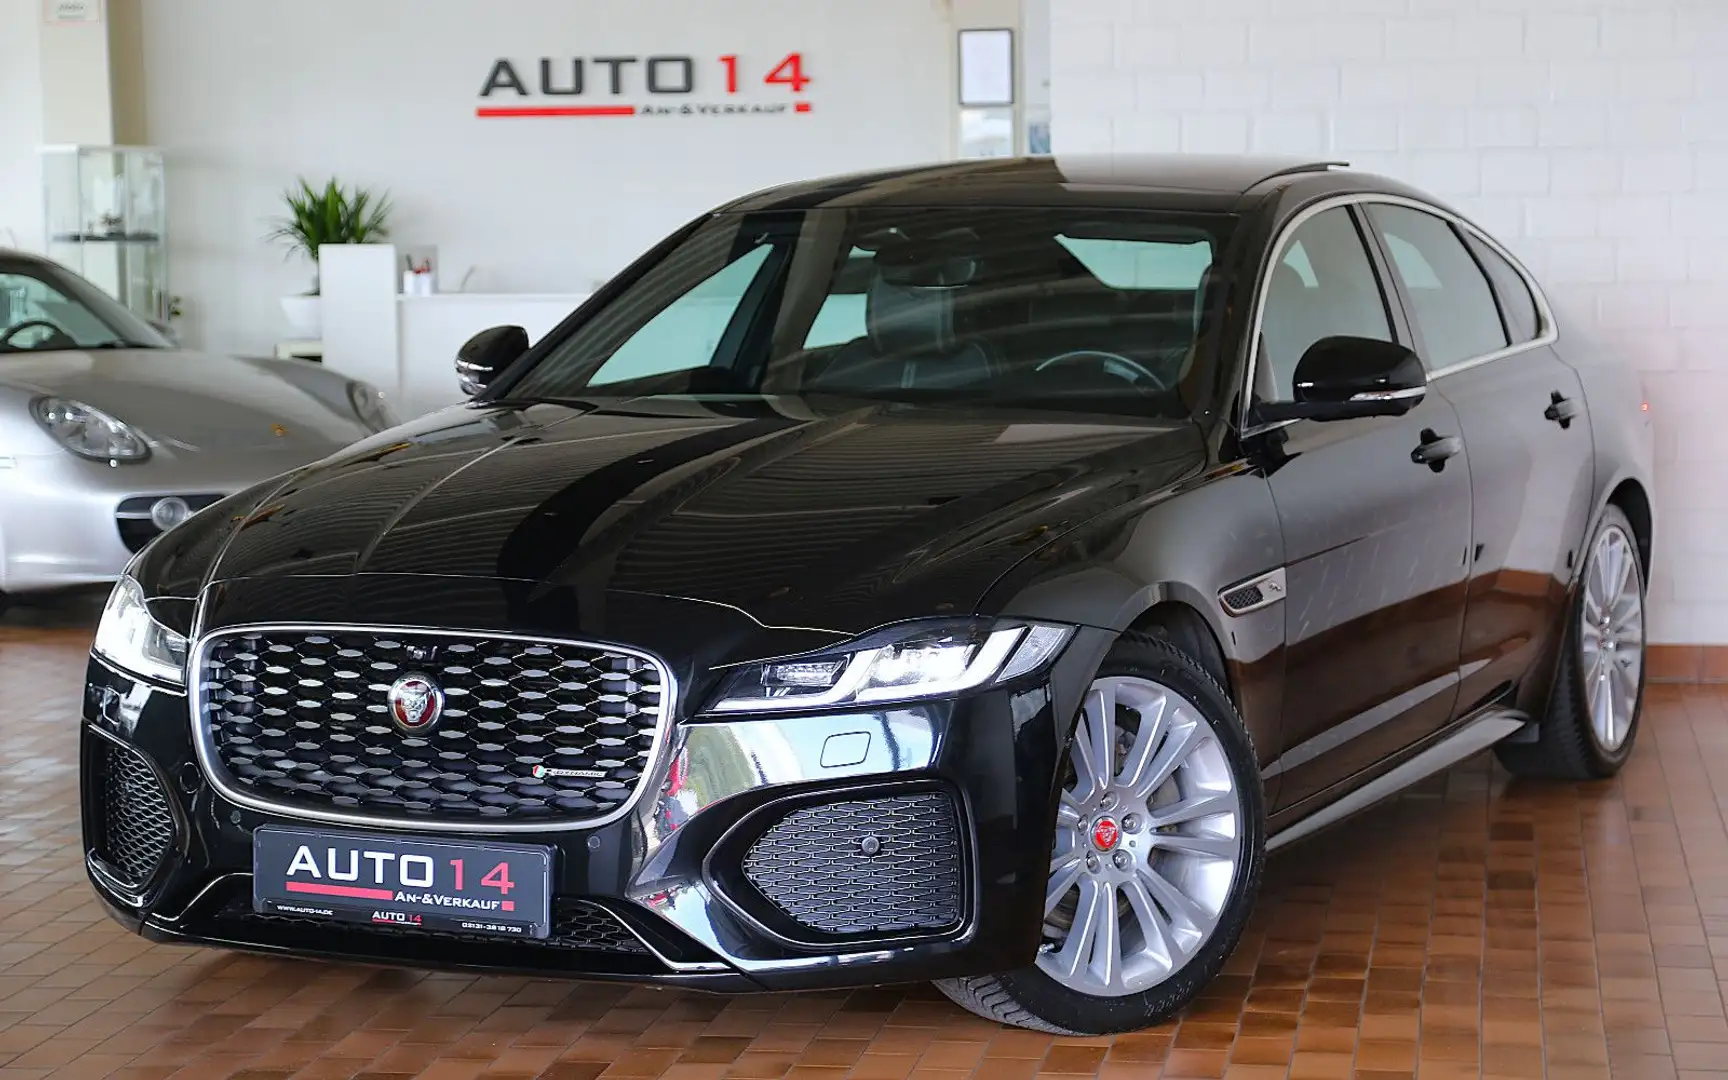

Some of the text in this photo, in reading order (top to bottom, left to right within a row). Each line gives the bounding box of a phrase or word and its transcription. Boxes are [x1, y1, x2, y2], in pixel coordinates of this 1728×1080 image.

[479, 52, 811, 96] AUTO 14
[286, 845, 514, 895] AUTO 14
[372, 910, 422, 923] AUTO 14
